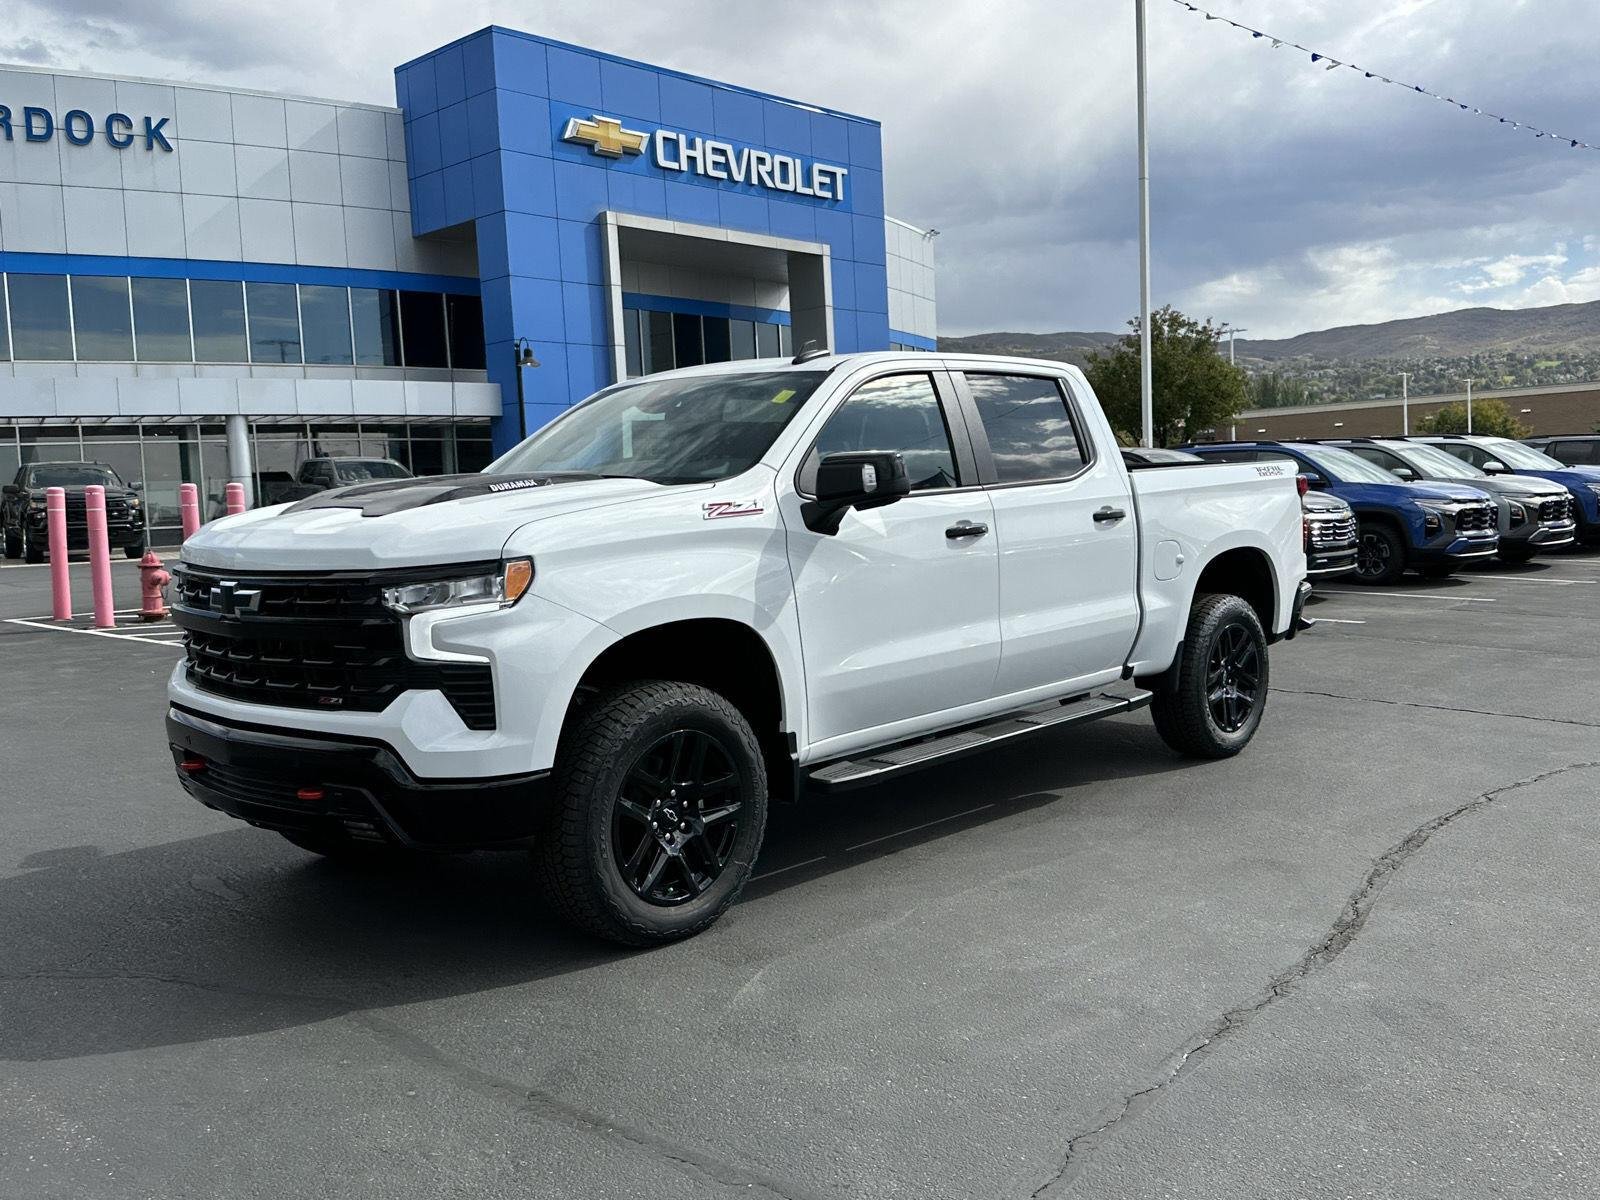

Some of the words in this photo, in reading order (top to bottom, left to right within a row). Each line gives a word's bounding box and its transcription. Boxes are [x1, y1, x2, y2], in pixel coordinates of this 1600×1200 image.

[655, 129, 848, 200] CHEVROLET
[489, 479, 538, 492] DURAMAX
[702, 500, 764, 520] Z71
